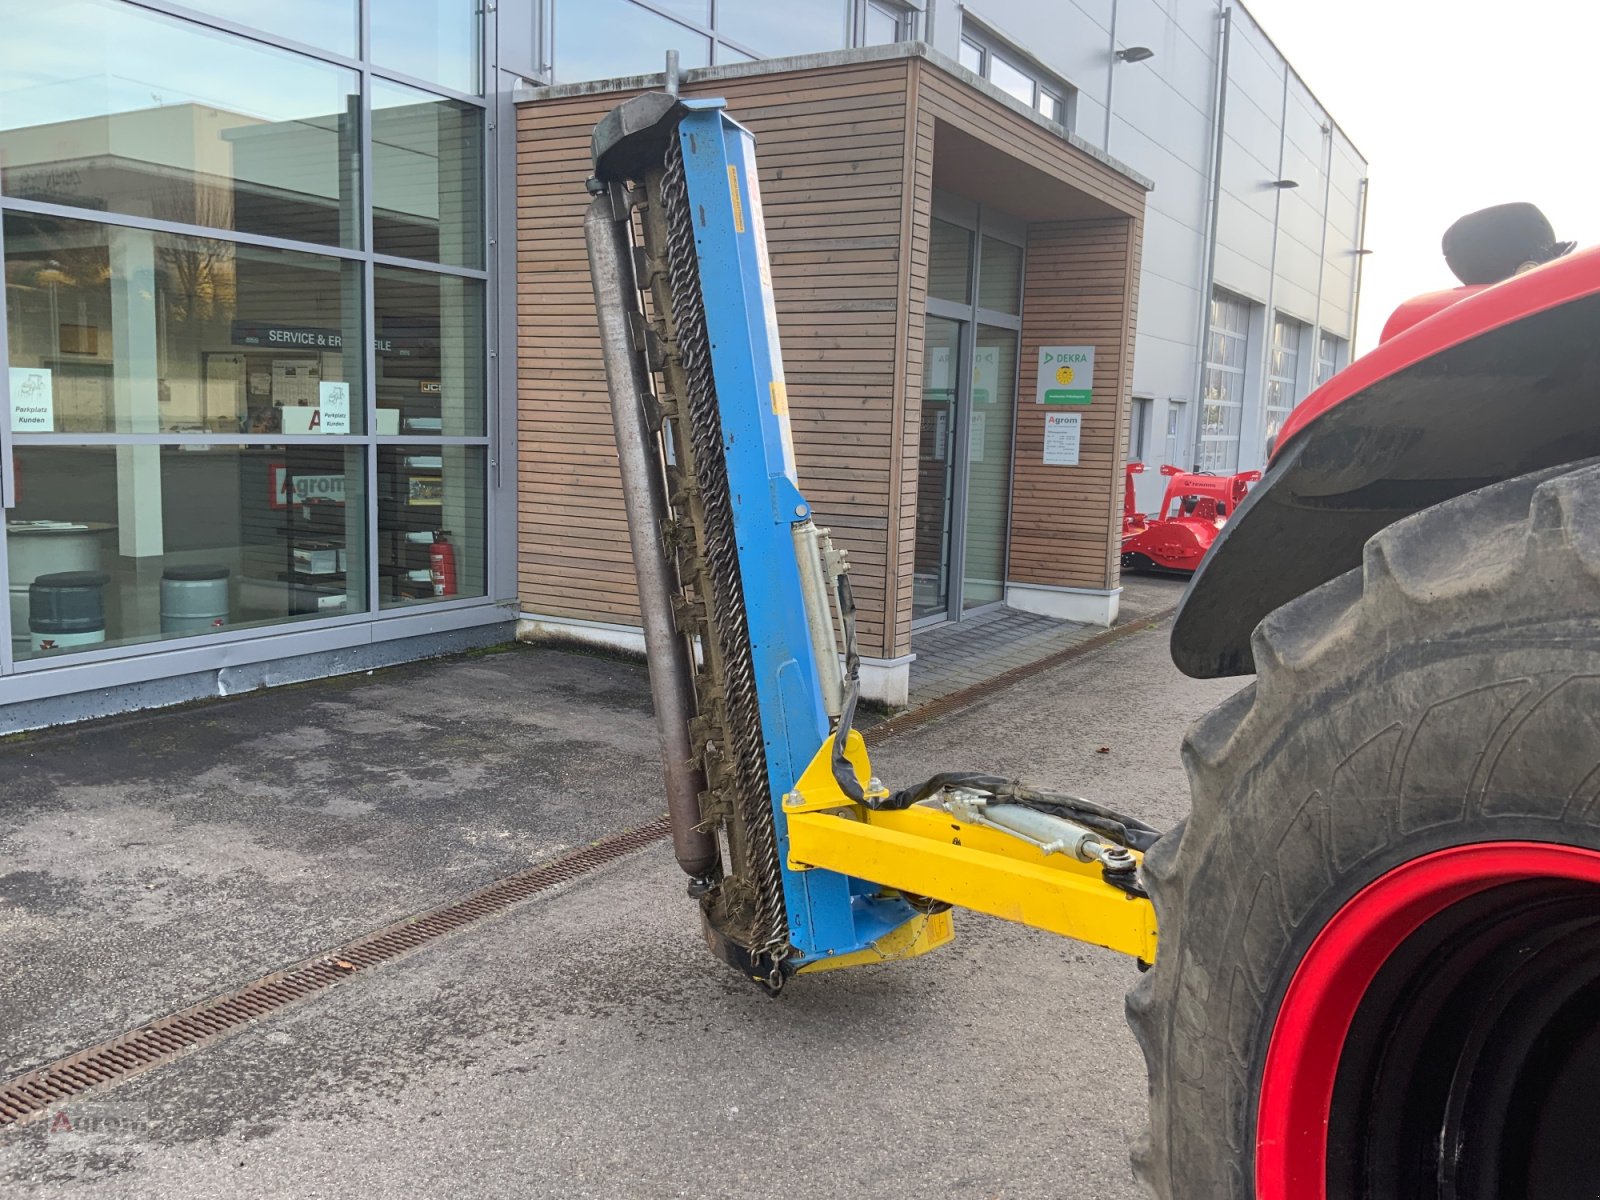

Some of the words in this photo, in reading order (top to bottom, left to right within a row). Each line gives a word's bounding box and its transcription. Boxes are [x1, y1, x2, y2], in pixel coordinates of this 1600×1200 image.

[269, 330, 315, 345] SERVICE
[318, 335, 326, 345] &
[1056, 353, 1087, 363] DEKRA
[15, 406, 47, 414] Parkplatz
[1049, 416, 1078, 425] Agrom
